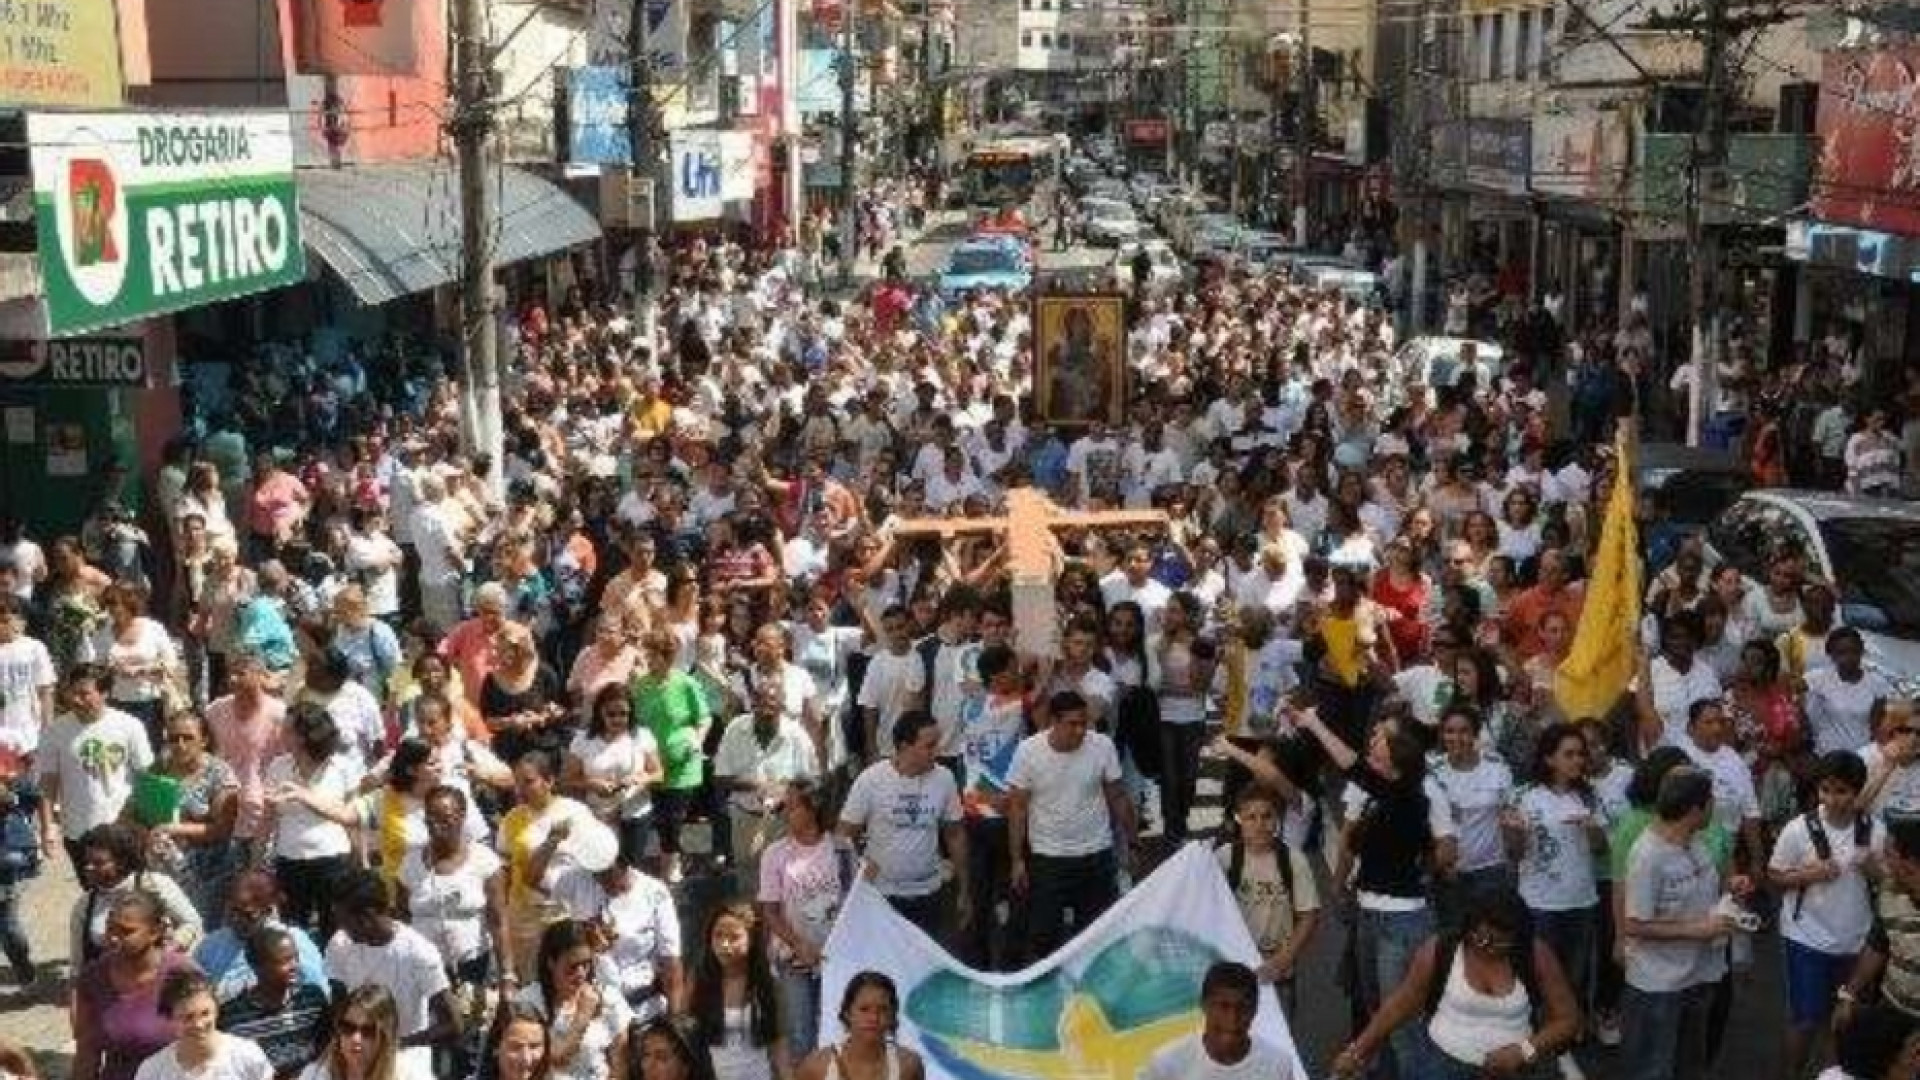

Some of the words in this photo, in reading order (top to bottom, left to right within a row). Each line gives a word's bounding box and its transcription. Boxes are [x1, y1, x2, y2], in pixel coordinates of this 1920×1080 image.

[137, 126, 251, 166] DROGARIA
[146, 194, 288, 295] RETIRO
[50, 341, 142, 381] RETIRO
